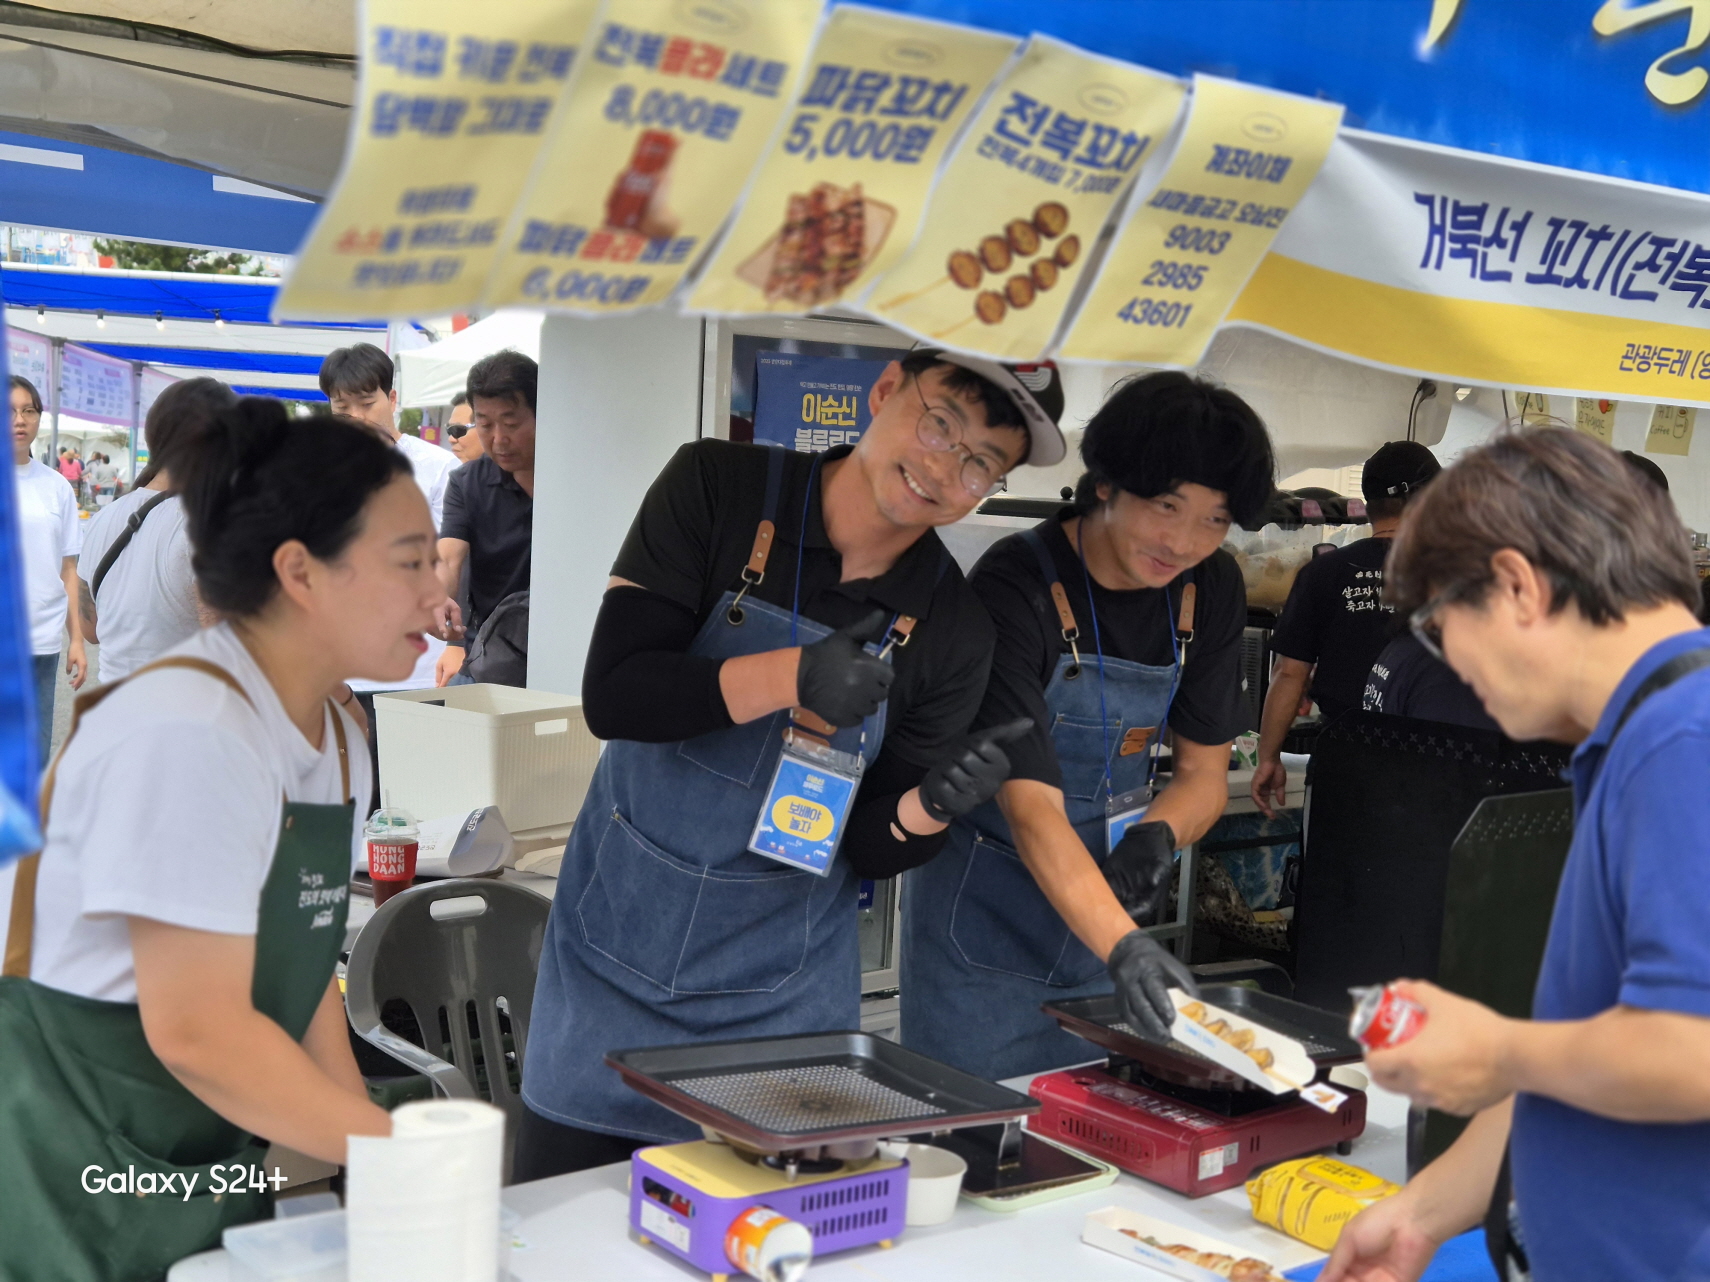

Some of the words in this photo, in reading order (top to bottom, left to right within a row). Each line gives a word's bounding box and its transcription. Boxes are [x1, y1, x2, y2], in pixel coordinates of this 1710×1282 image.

[800, 62, 970, 122] 파닭꼬치
[604, 83, 742, 142] 8,000원
[783, 113, 936, 164] 5,000원
[992, 89, 1152, 173] 전복꼬치
[1205, 143, 1293, 184] 계좌이체
[1065, 167, 1123, 195] 7,000원
[1164, 223, 1233, 255] 9003
[1413, 191, 1534, 283] 거북선
[1524, 215, 1710, 310] 꼬치(전복
[521, 265, 652, 305] 6,000원
[1141, 259, 1210, 292] 2985
[1117, 296, 1193, 329] 43601
[1619, 342, 1693, 378] 관광두레
[801, 392, 858, 426] 이순신
[1342, 586, 1374, 599] 살고자
[1345, 599, 1376, 613] 죽고자
[787, 801, 822, 822] 보배야
[788, 816, 812, 834] 놀자
[373, 853, 405, 865] HONG
[373, 863, 405, 875] DAAN
